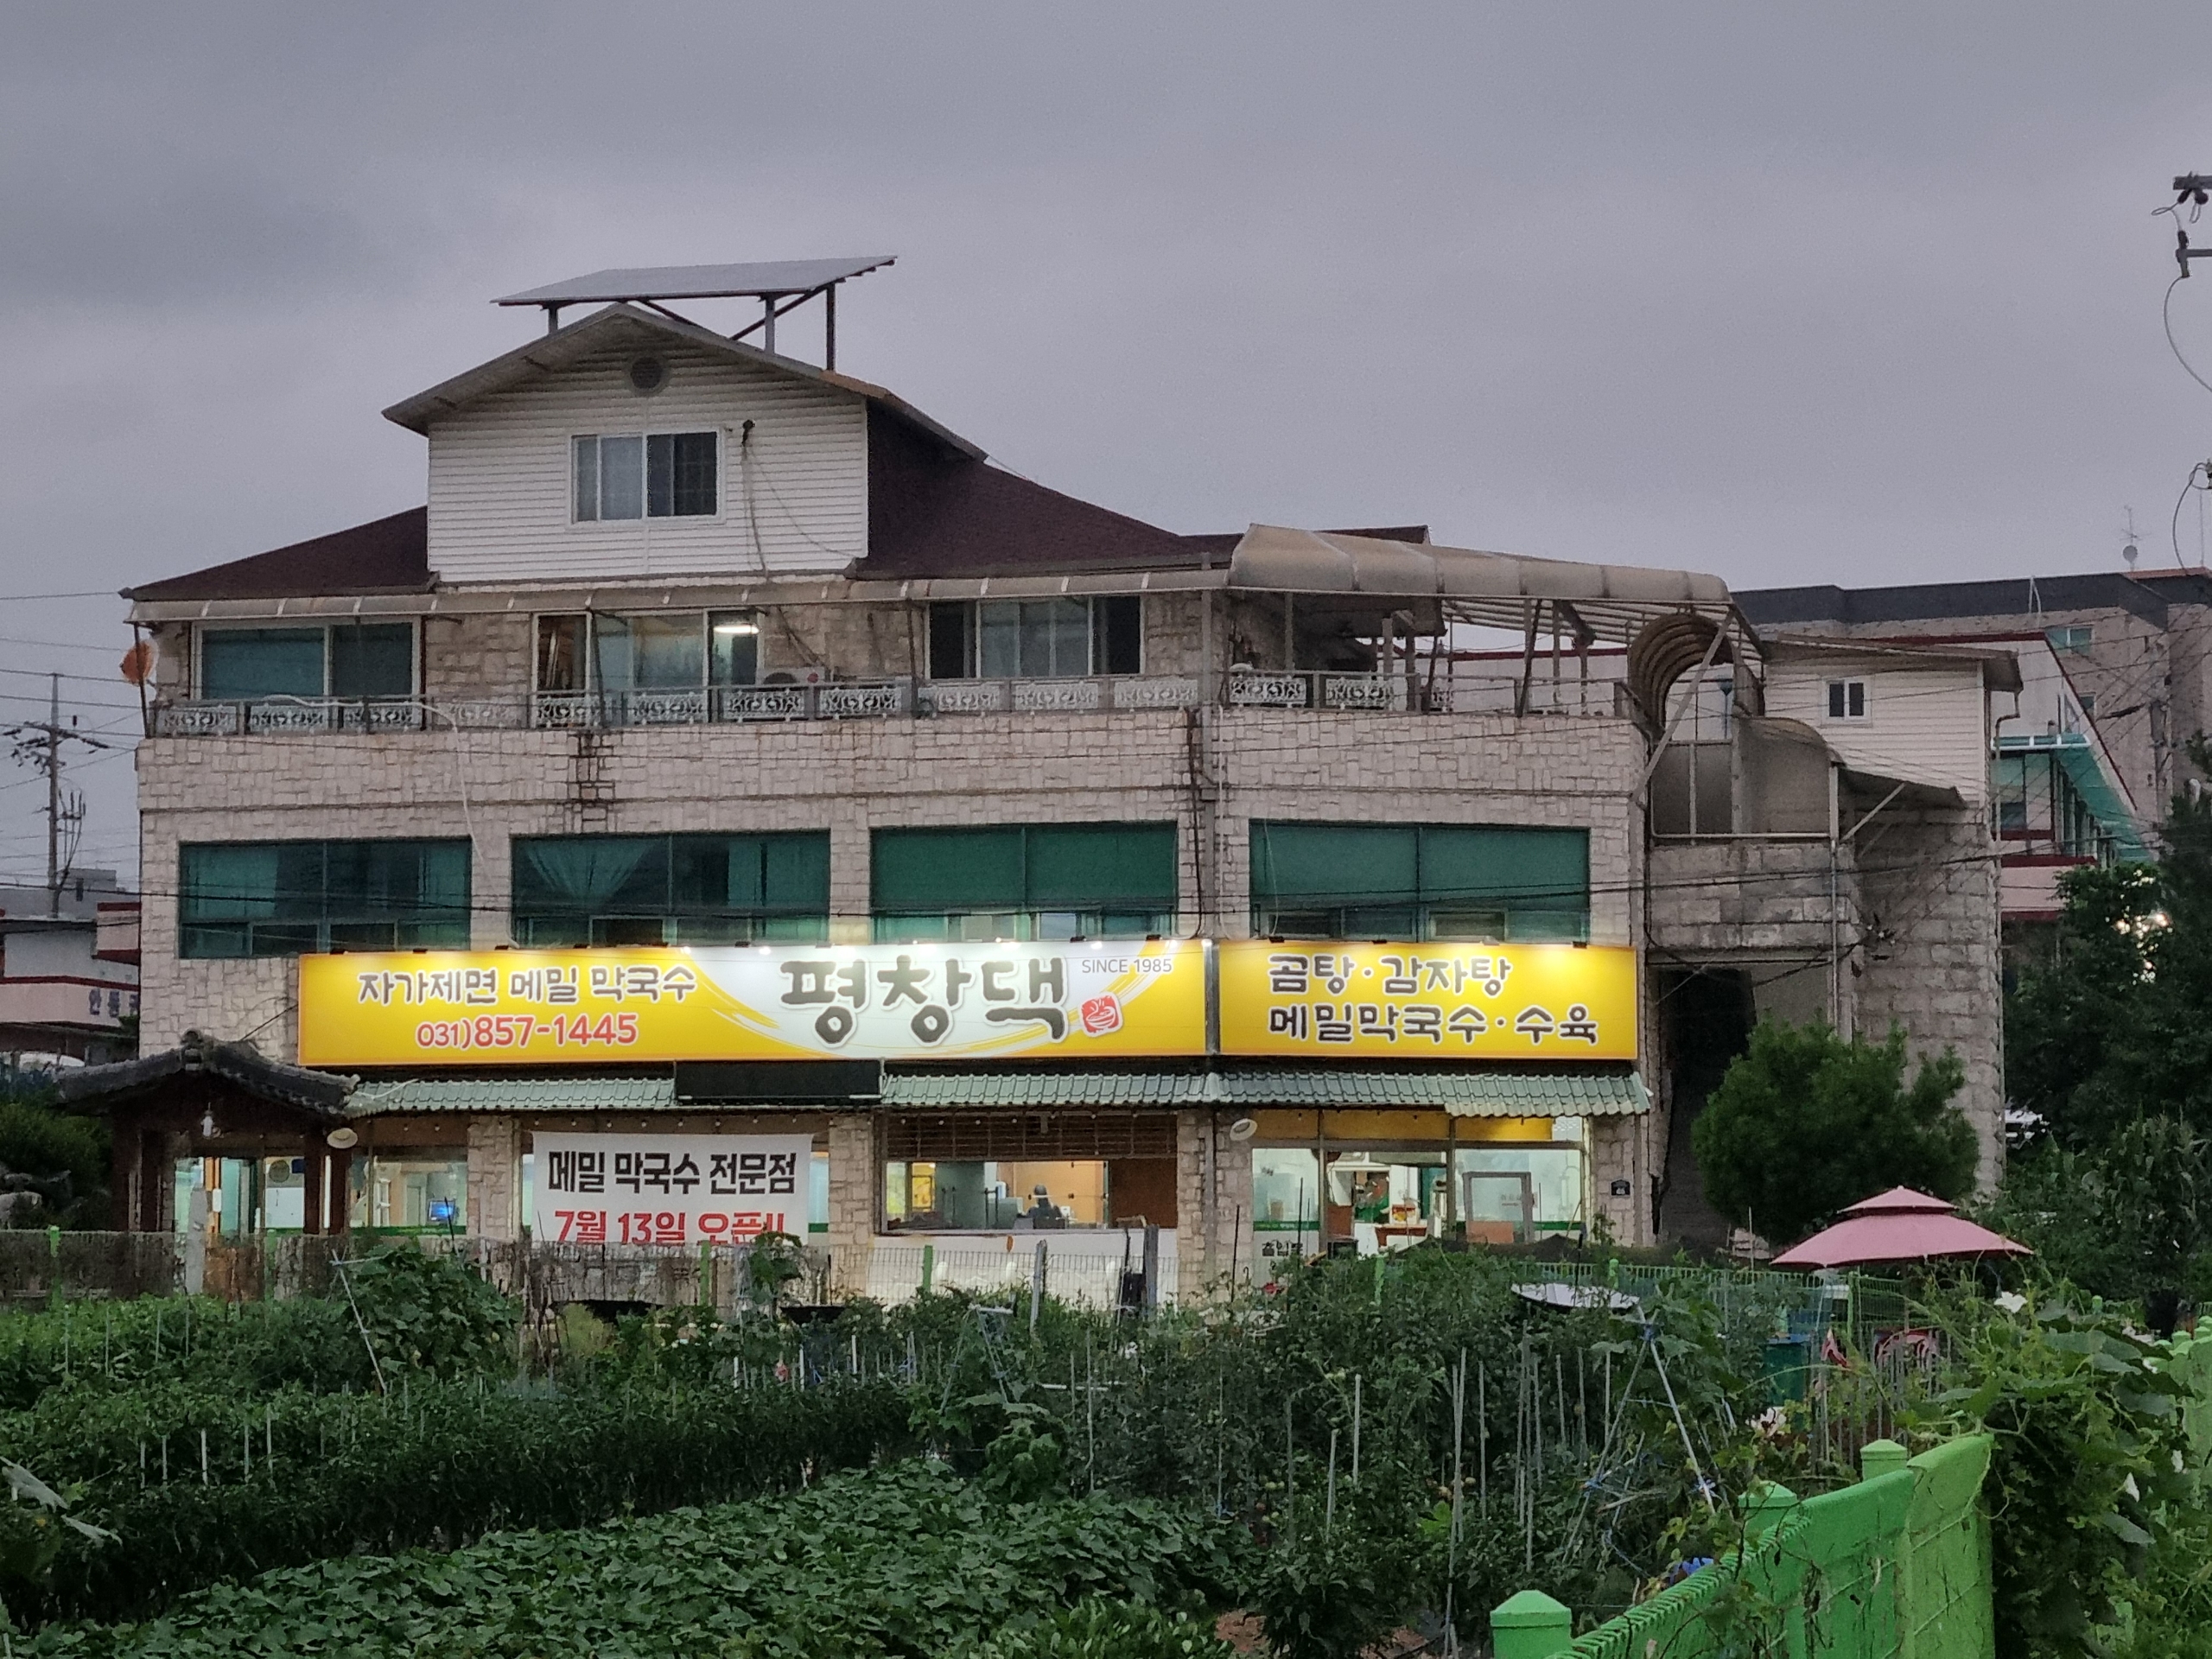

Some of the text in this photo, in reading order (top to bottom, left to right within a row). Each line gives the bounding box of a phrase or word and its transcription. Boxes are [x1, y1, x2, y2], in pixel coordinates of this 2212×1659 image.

[357, 963, 697, 1006] 자가제면 메밀 막국수
[1081, 957, 1173, 974] SINCE 1985
[779, 956, 1068, 1045] 평창댁
[416, 1013, 638, 1049] 031)857-1445
[548, 1151, 795, 1194] 메밀 막국수 전문점
[555, 1211, 607, 1244] 7월
[618, 1211, 686, 1246] 13일
